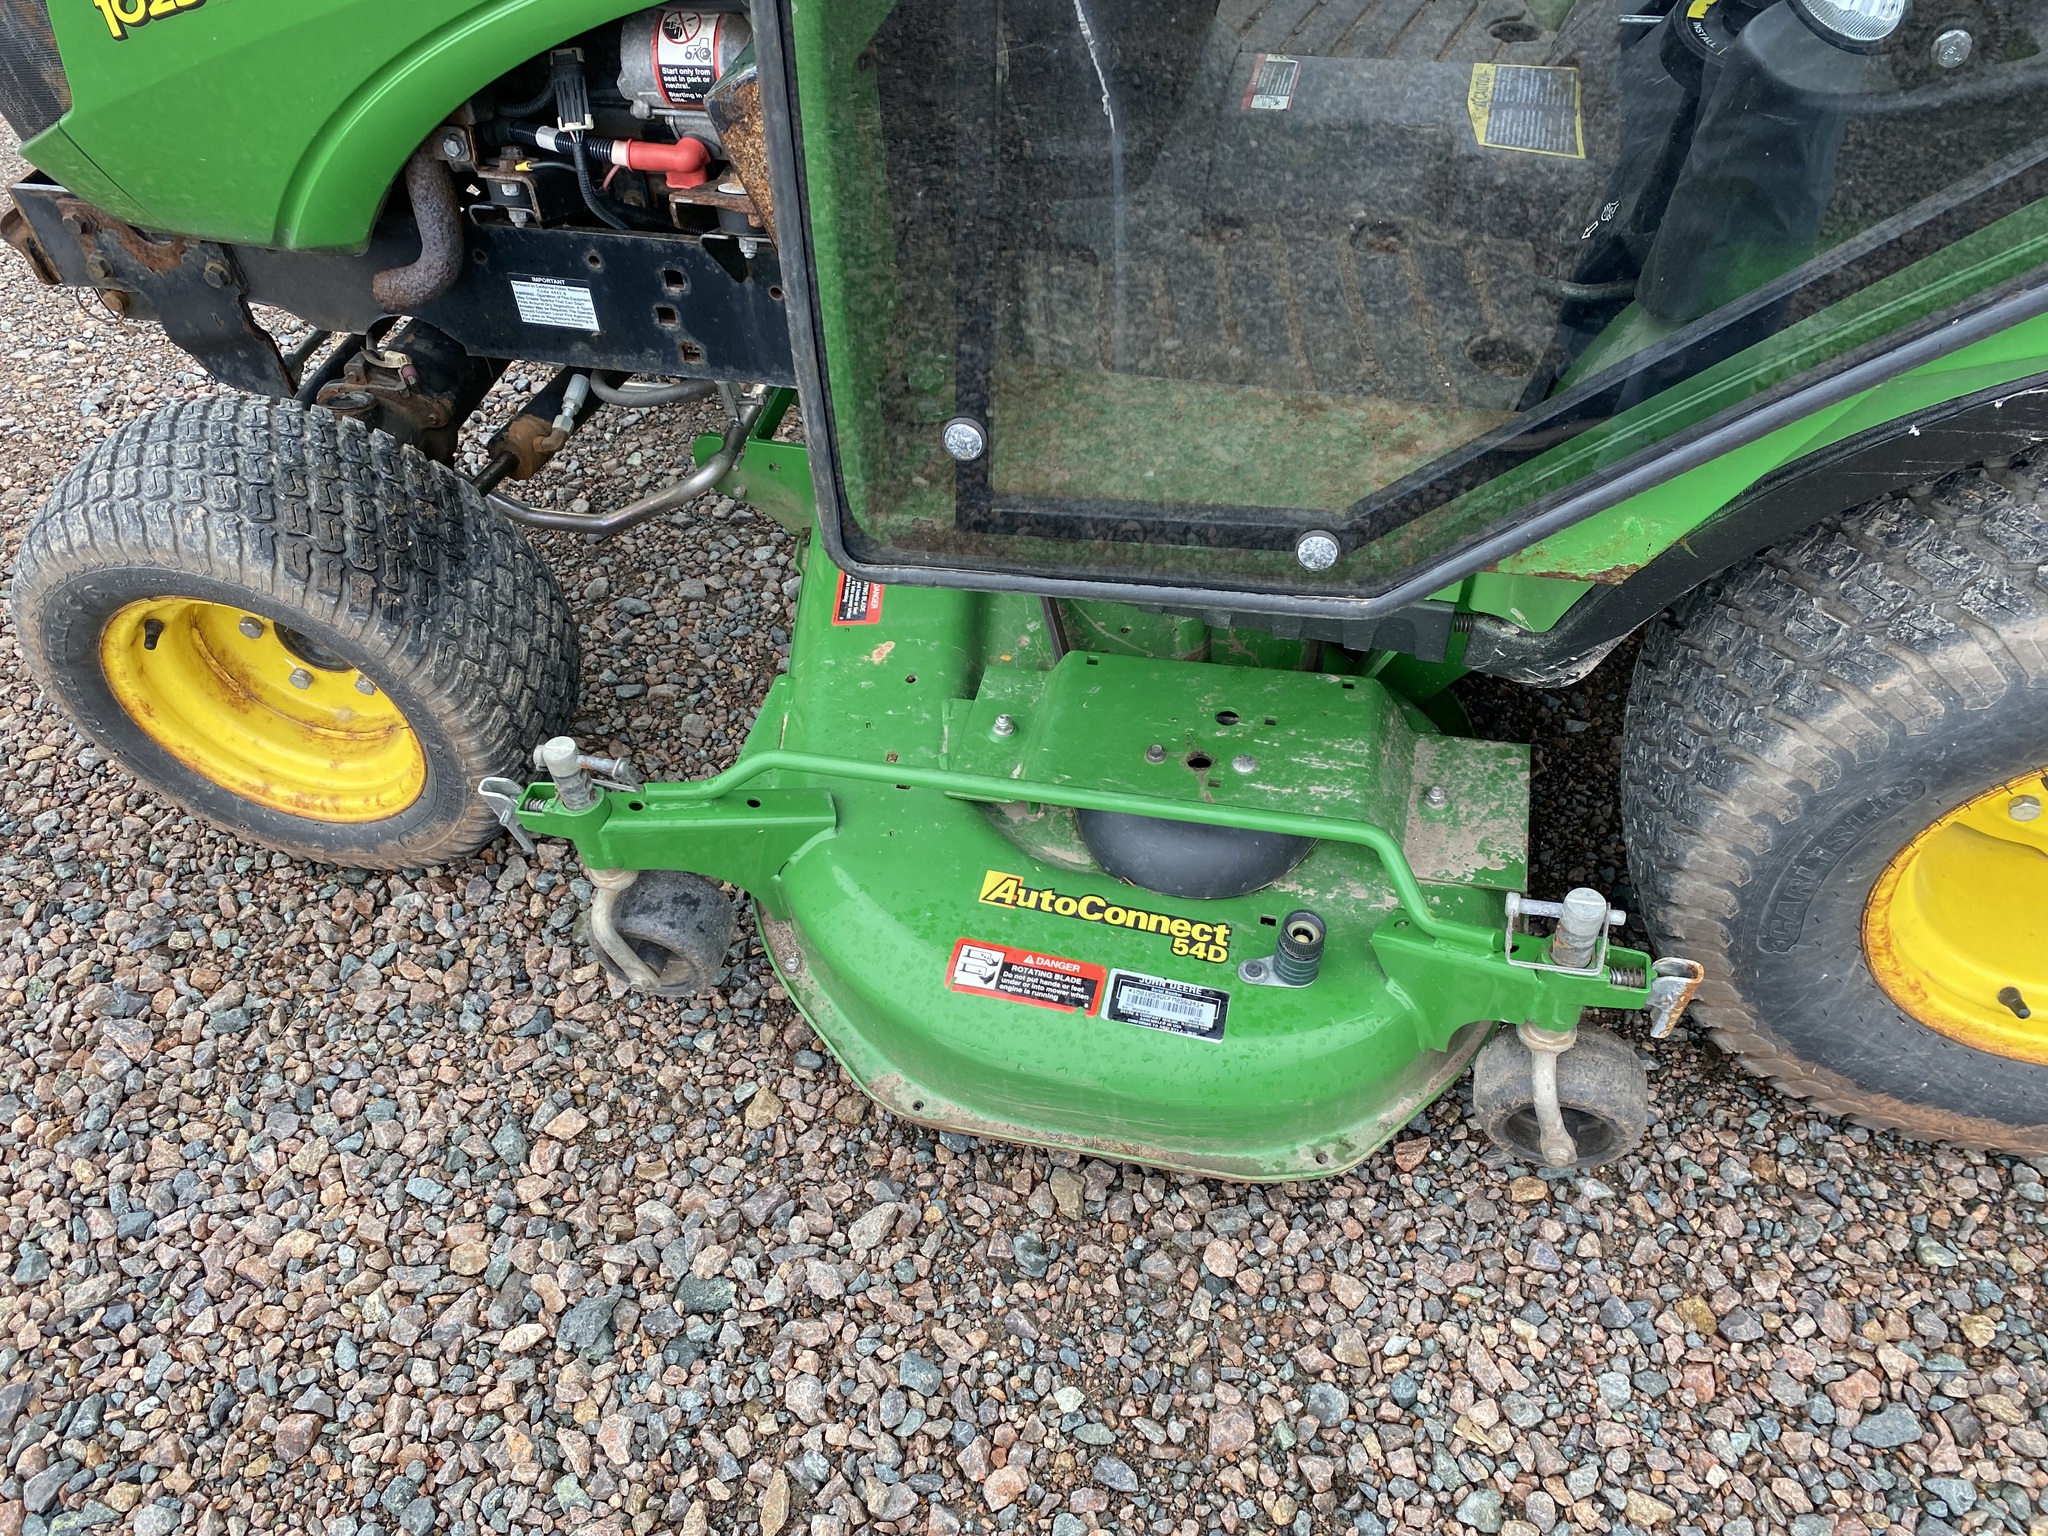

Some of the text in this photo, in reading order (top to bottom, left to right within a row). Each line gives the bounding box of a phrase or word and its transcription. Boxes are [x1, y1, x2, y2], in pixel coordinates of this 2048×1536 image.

[1692, 21, 1717, 49] INSTALL
[661, 66, 711, 76] Start only from
[686, 75, 702, 83] park
[668, 91, 695, 99] Starting
[531, 277, 565, 285] IMPORTANT
[861, 580, 869, 596] ATING
[870, 583, 881, 610] DANGER
[985, 877, 1231, 947] AutoConnect
[1172, 939, 1229, 963] 54D
[1035, 956, 1081, 973] DANGER
[1002, 971, 1013, 979] Do
[1014, 972, 1026, 980] not
[1026, 976, 1039, 984] put
[1039, 978, 1061, 988] hands
[1070, 984, 1084, 993] feet
[1011, 964, 1083, 985] ROTATING BLADE
[999, 983, 1023, 993] engine
[1031, 990, 1059, 1002] running
[1001, 977, 1021, 987] under
[1031, 983, 1045, 992] into
[1045, 987, 1070, 996] mower
[1070, 991, 1089, 1000] when
[1139, 977, 1202, 995] JOHN DEERE
